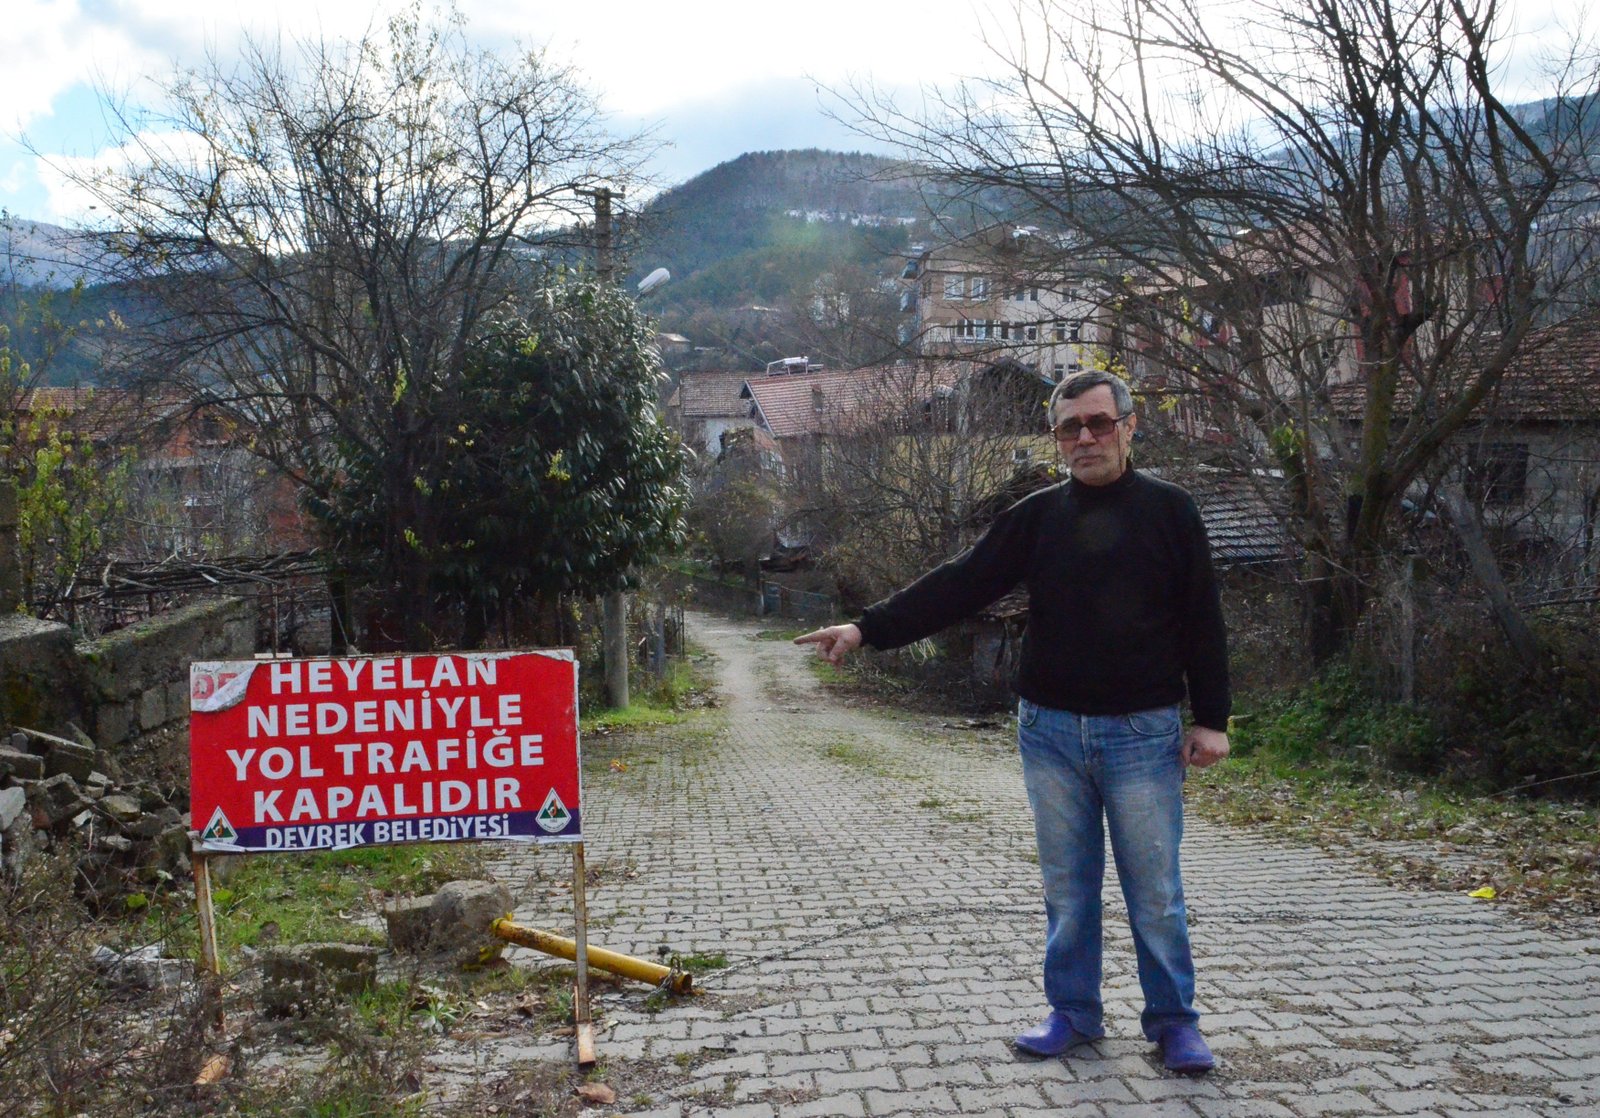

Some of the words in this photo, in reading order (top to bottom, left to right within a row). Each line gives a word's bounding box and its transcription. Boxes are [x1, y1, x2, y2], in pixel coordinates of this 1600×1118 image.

[270, 657, 497, 694] HEYELAN
[247, 690, 523, 738] NEDENİYLE
[226, 747, 324, 781] YOL
[335, 728, 544, 775] TRAFİĞE
[253, 778, 522, 823] KAPALIDIR
[265, 823, 366, 849] DEVREK
